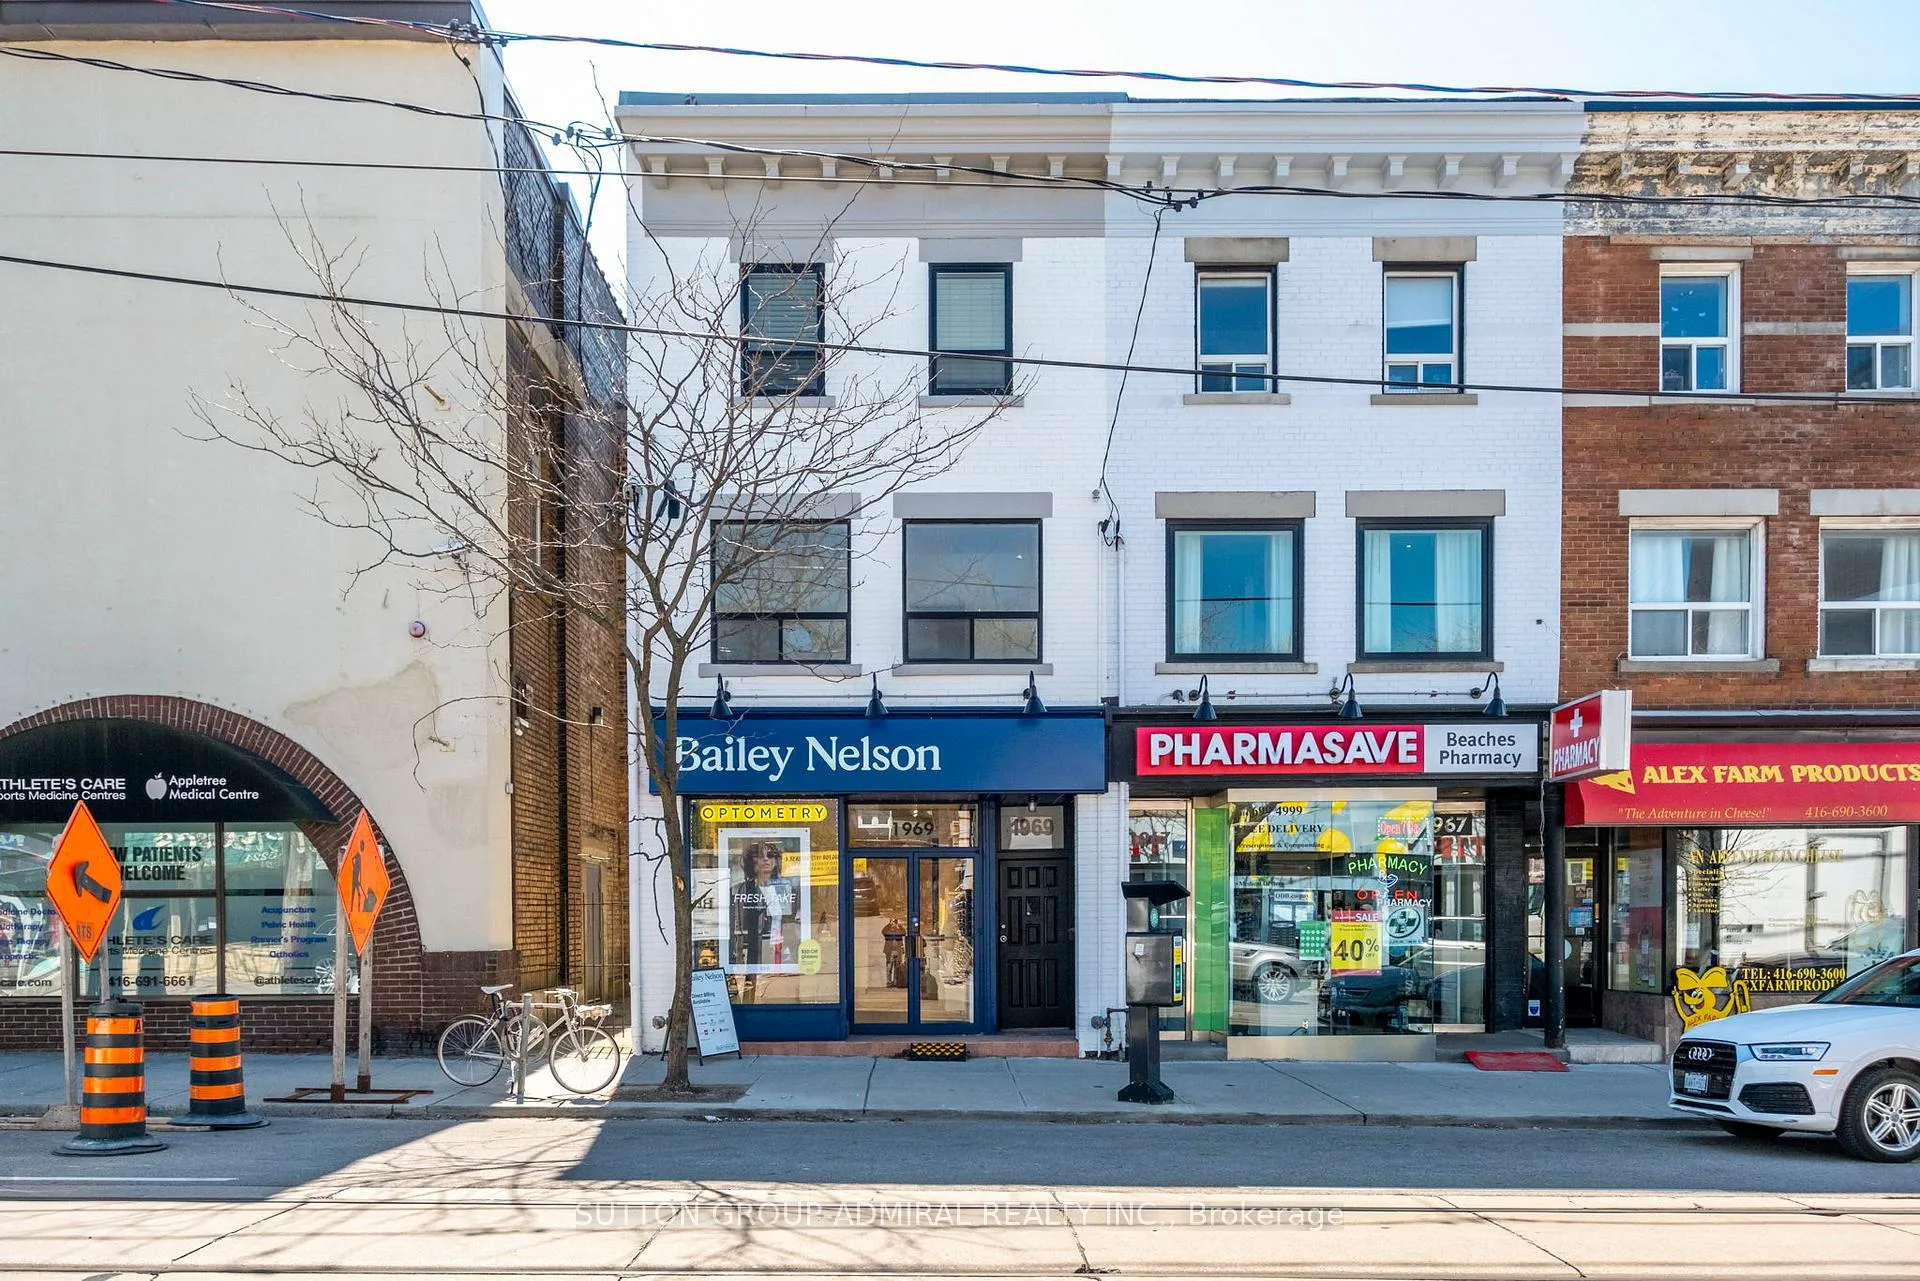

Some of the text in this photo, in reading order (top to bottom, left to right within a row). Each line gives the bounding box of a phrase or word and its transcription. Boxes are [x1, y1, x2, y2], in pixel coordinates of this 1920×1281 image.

[1446, 732, 1516, 747] Beaches
[1150, 731, 1418, 766] PHARMASAVE
[1553, 736, 1600, 772] PHARMACY
[676, 736, 941, 782] Bailey Nelson
[1439, 750, 1522, 768] Pharmacy
[1642, 764, 1920, 784] ALEX FARM PRODUCTS
[0, 778, 126, 790] THLETE'S CARE
[169, 774, 227, 788] Appletree
[28, 791, 79, 801] Medicine
[81, 791, 126, 801] Centres
[169, 788, 260, 800] Medical Centre
[702, 807, 826, 820] OPTOMETRY
[1648, 808, 1707, 820] Adventure
[1710, 808, 1721, 819] in
[1805, 805, 1889, 818] 416-690-3600
[893, 821, 935, 837] 1969
[1268, 824, 1324, 833] DELIVERY
[132, 846, 202, 862] PATIENTS
[1348, 856, 1428, 874] PHARMACY
[733, 893, 766, 903] FRESH
[1377, 898, 1433, 908] PHARMACY
[261, 906, 316, 915] Acupuncture
[1356, 912, 1379, 922] SALE
[289, 921, 317, 929] Health
[291, 936, 328, 945] Program
[1742, 967, 1846, 980] TEL: 416-690-3600
[108, 976, 194, 987] 416-691-6661
